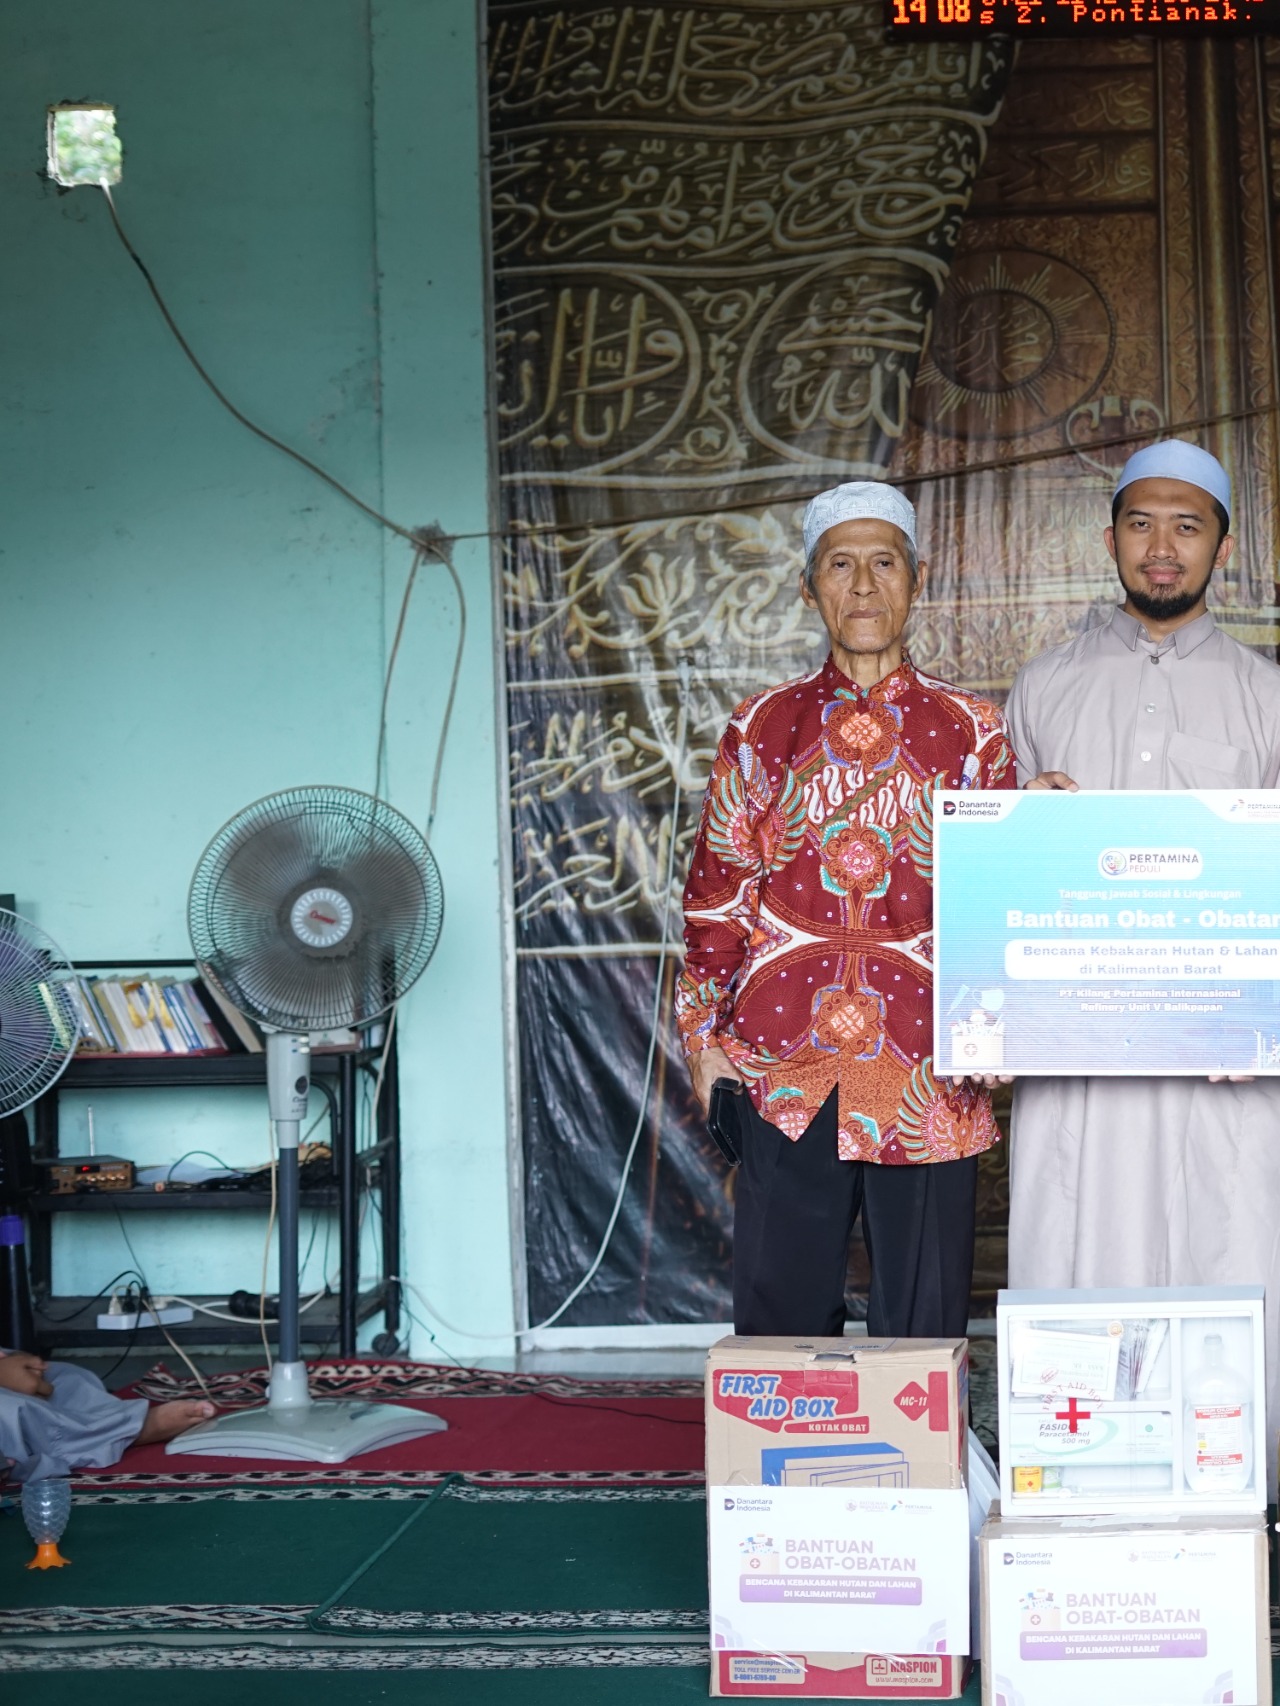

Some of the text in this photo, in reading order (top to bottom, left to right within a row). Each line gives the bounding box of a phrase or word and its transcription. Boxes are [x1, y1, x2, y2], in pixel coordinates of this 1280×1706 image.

[1073, 3, 1251, 23] Pontianak.
[958, 800, 1001, 808] Danantara
[958, 809, 998, 817] Indonesia
[1129, 853, 1200, 864] PERTAMINA
[1129, 864, 1161, 873] PEDULI
[1059, 889, 1107, 900] Tanggung
[1142, 889, 1171, 899] Sosial
[1184, 889, 1242, 900] Lingkungan
[1007, 909, 1109, 928] Bantuan
[1117, 909, 1176, 928] Obat
[1023, 945, 1278, 956] Bencana Kebakaran Hutan & Lahan
[1079, 963, 1223, 975] di Kalimantan Barat
[1059, 988, 1241, 1000] PT Kilang Pertamina Internasional
[1080, 1003, 1223, 1014] Refinery Unit V Balikpapan
[721, 1375, 780, 1396] FIRST
[1067, 1381, 1087, 1391] AID
[900, 1396, 928, 1407] MC-11
[749, 1398, 837, 1418] AID BOX
[808, 1423, 867, 1432] KOTAK OBAT
[736, 1504, 771, 1512] Indonesia
[785, 1539, 874, 1554] BANTUAN
[784, 1555, 917, 1572] OBAT-OBATAN
[745, 1579, 917, 1589] BENCANA KEBAKARAN HUTAN DAN LAHAN
[794, 1591, 848, 1599] KALIMANTAN
[849, 1591, 877, 1599] BARAT
[1066, 1592, 1157, 1608] BANTUAN
[1065, 1608, 1201, 1625] OBAT-OBATAN
[1026, 1633, 1201, 1643] BENCANA KEBAKARAN HUTAN DAN LAHAN
[1076, 1646, 1131, 1654] KALIMANTAN
[1132, 1645, 1161, 1653] BARAT
[890, 1661, 937, 1673] MASPION
